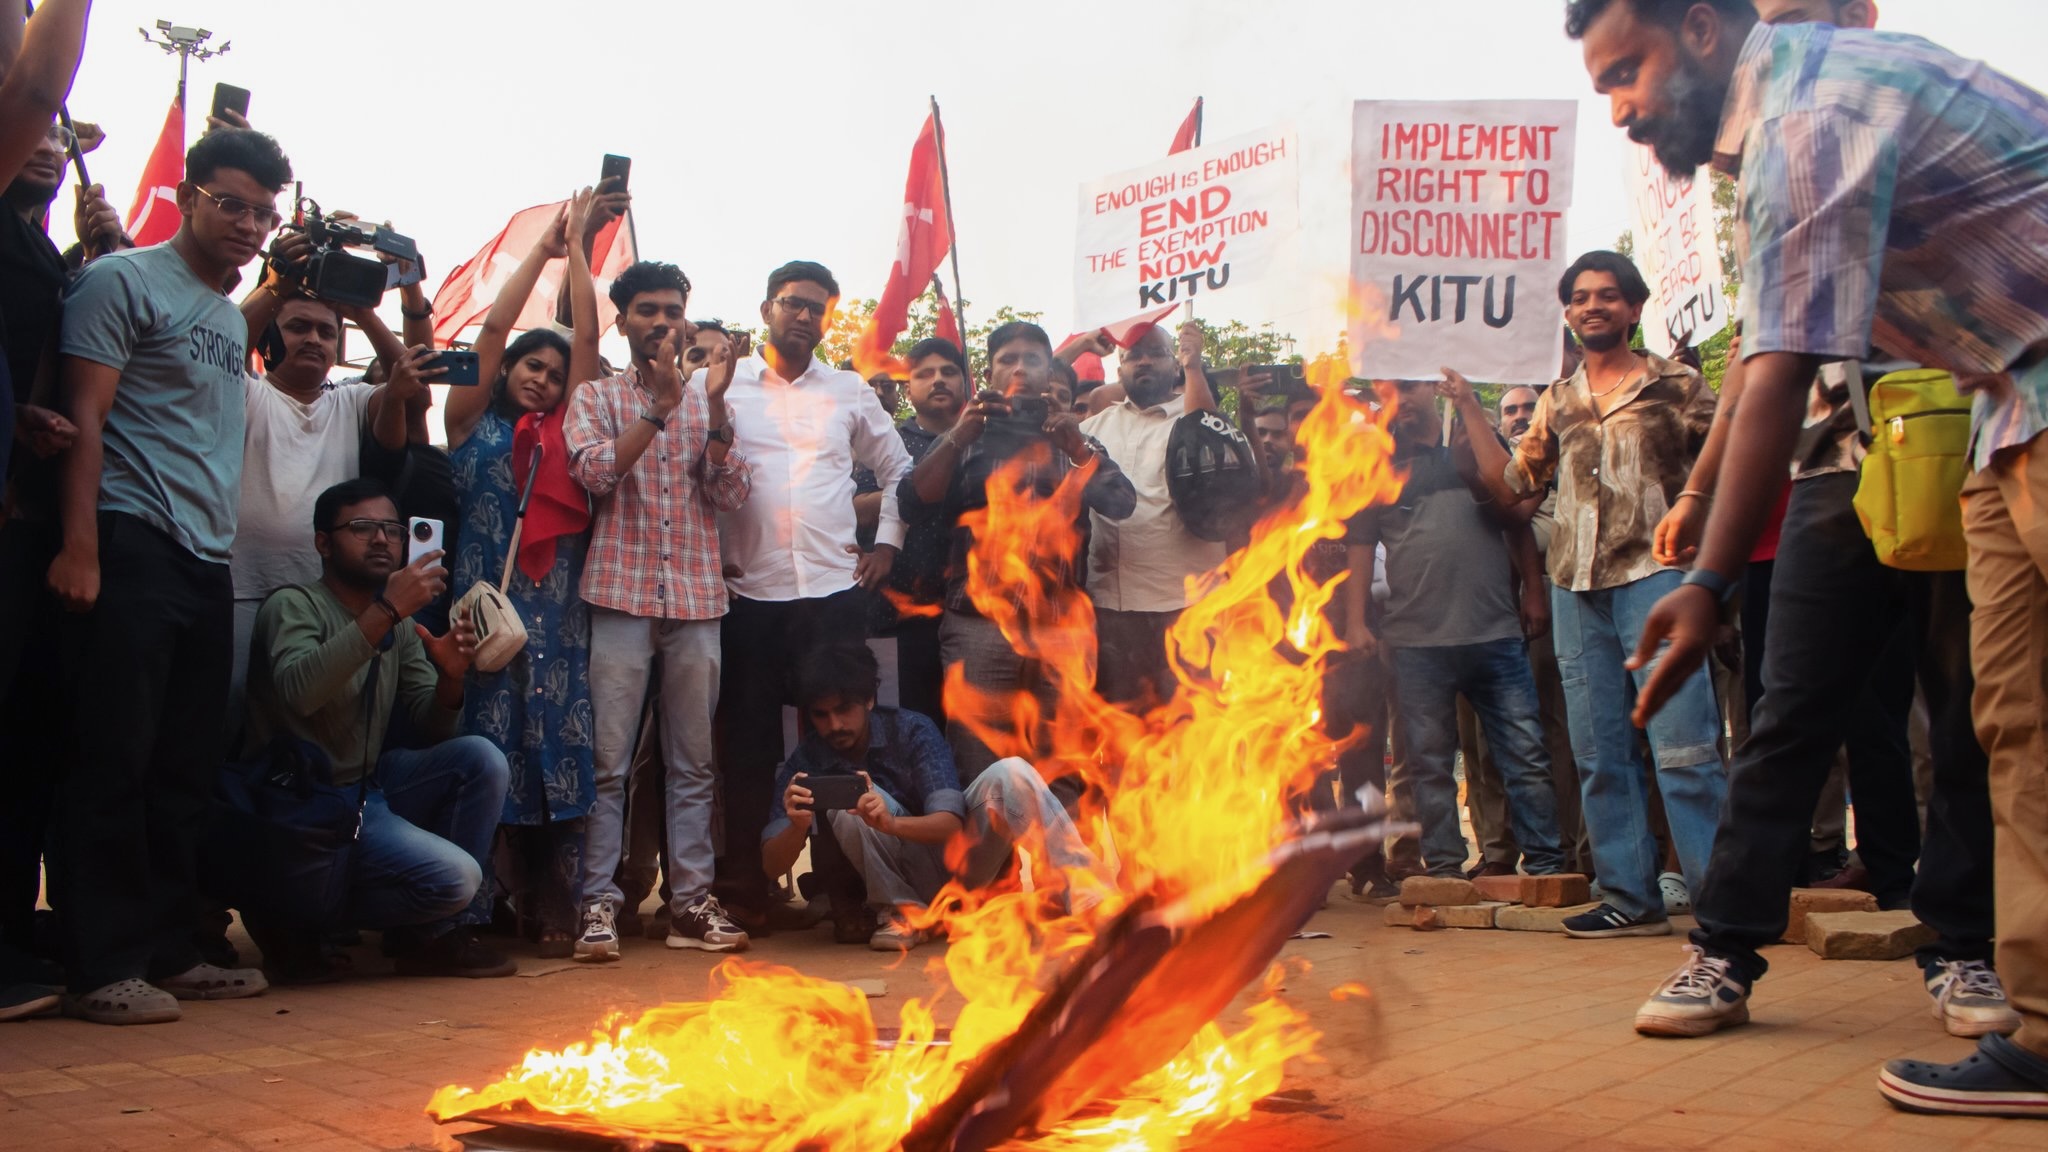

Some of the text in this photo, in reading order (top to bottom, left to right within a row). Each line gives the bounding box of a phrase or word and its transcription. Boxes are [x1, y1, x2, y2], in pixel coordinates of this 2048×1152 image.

[1382, 123, 1559, 161] IMPLEMENT
[1095, 137, 1286, 215] ENOUGH IS ENOUGH
[1376, 167, 1549, 206] RIGHT TO
[1140, 185, 1232, 238] END
[1361, 209, 1562, 260] DISCONNECT
[1680, 203, 1701, 248] BE
[1085, 209, 1268, 273] THE EXEMPTION
[1139, 240, 1226, 283] NOW
[1139, 262, 1230, 309] KITU
[1389, 274, 1516, 329] KITU
[1666, 283, 1714, 349] KITU
